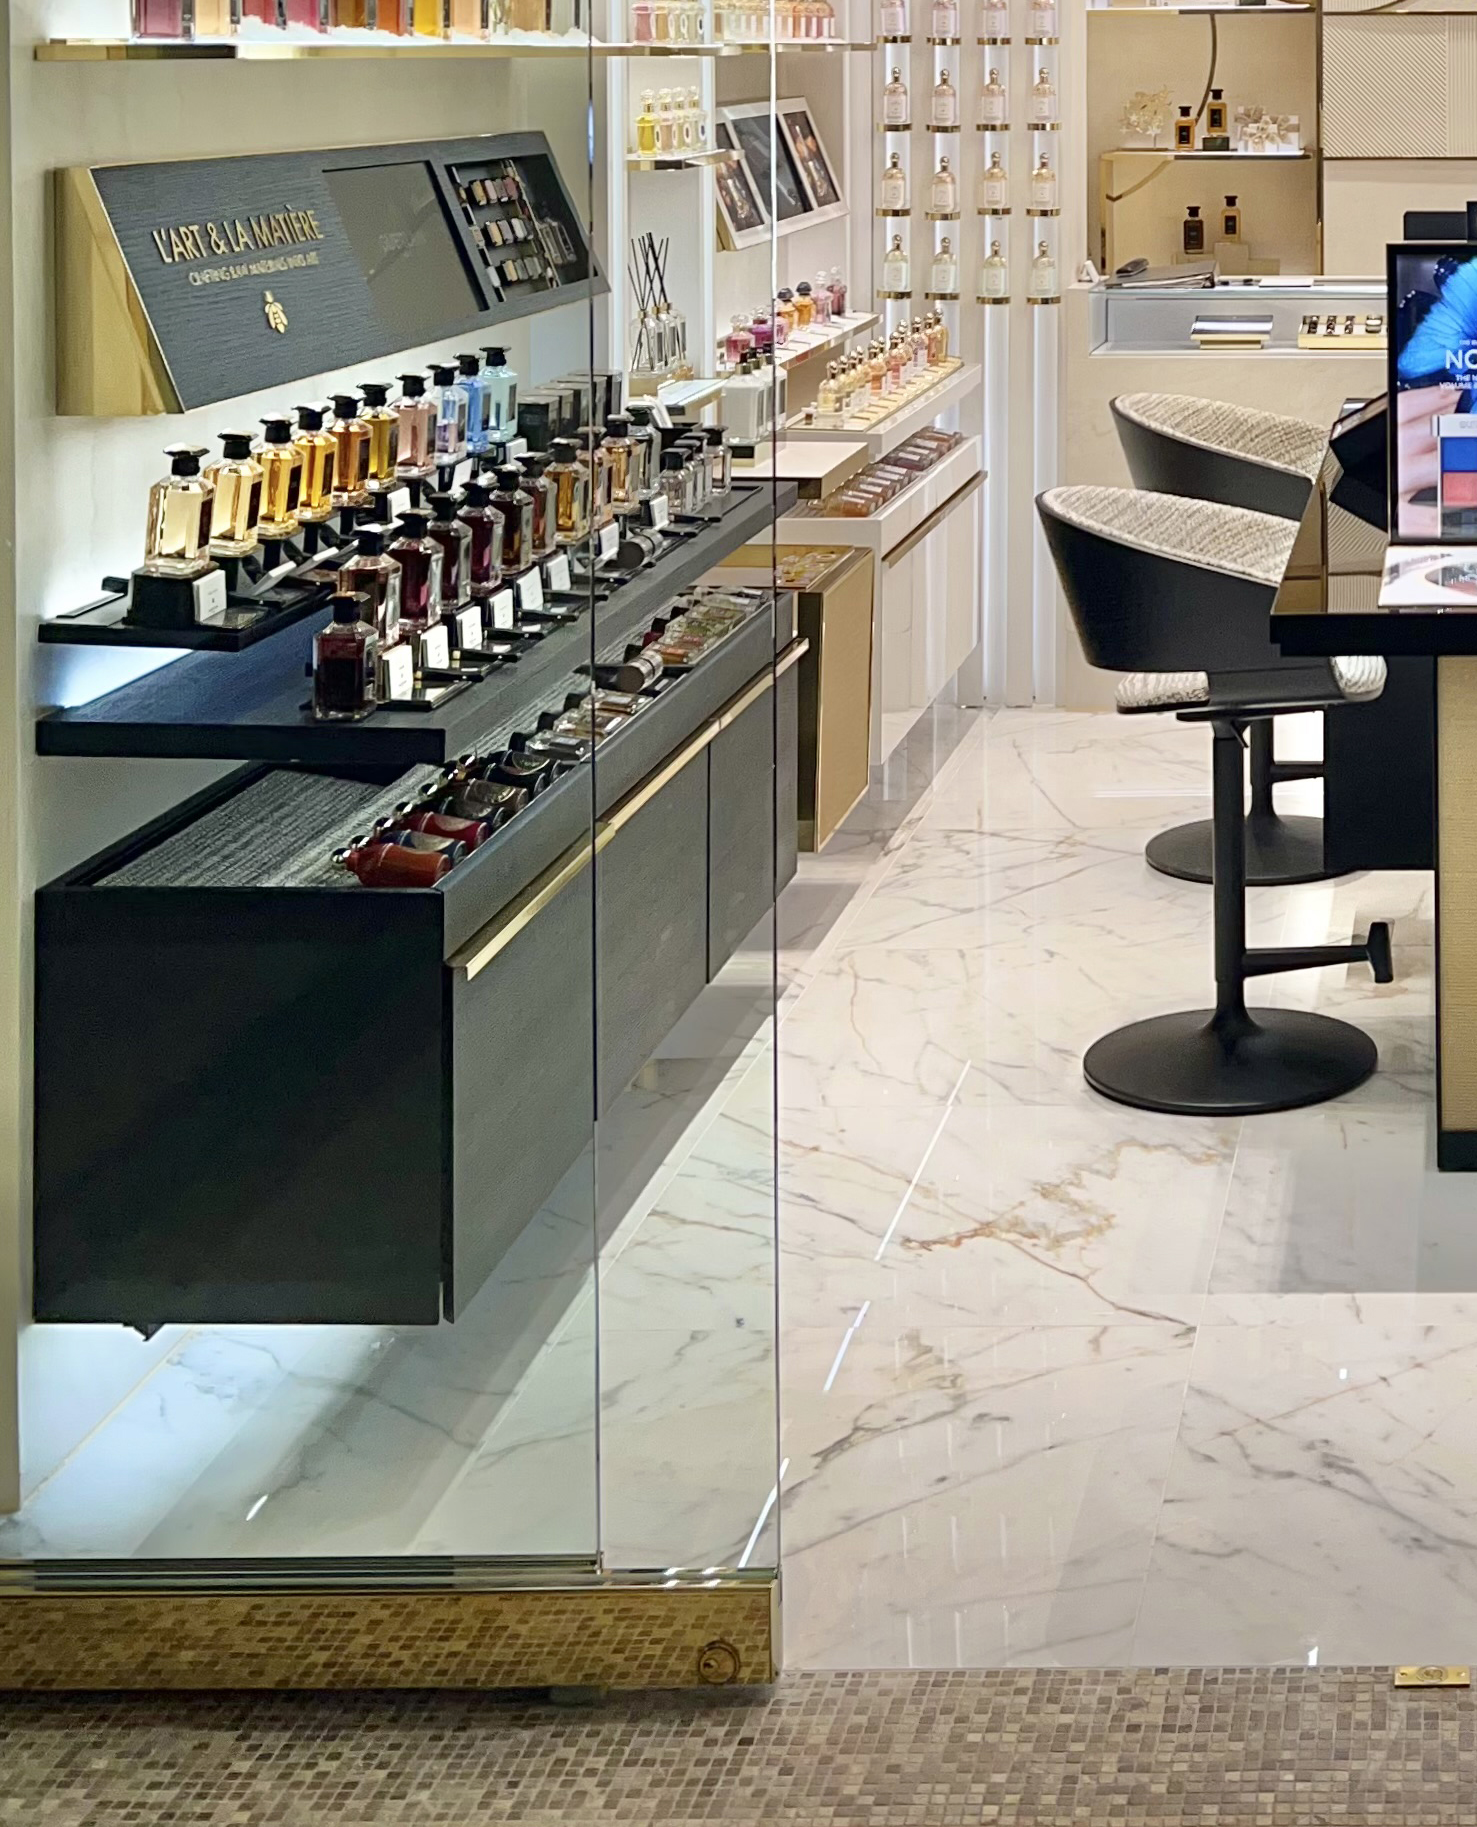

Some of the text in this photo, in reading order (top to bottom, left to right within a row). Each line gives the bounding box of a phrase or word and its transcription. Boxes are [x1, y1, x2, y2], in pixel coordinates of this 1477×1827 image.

[152, 204, 324, 263] L'ART & LA MATIÈRE
[1455, 374, 1471, 382] THE
